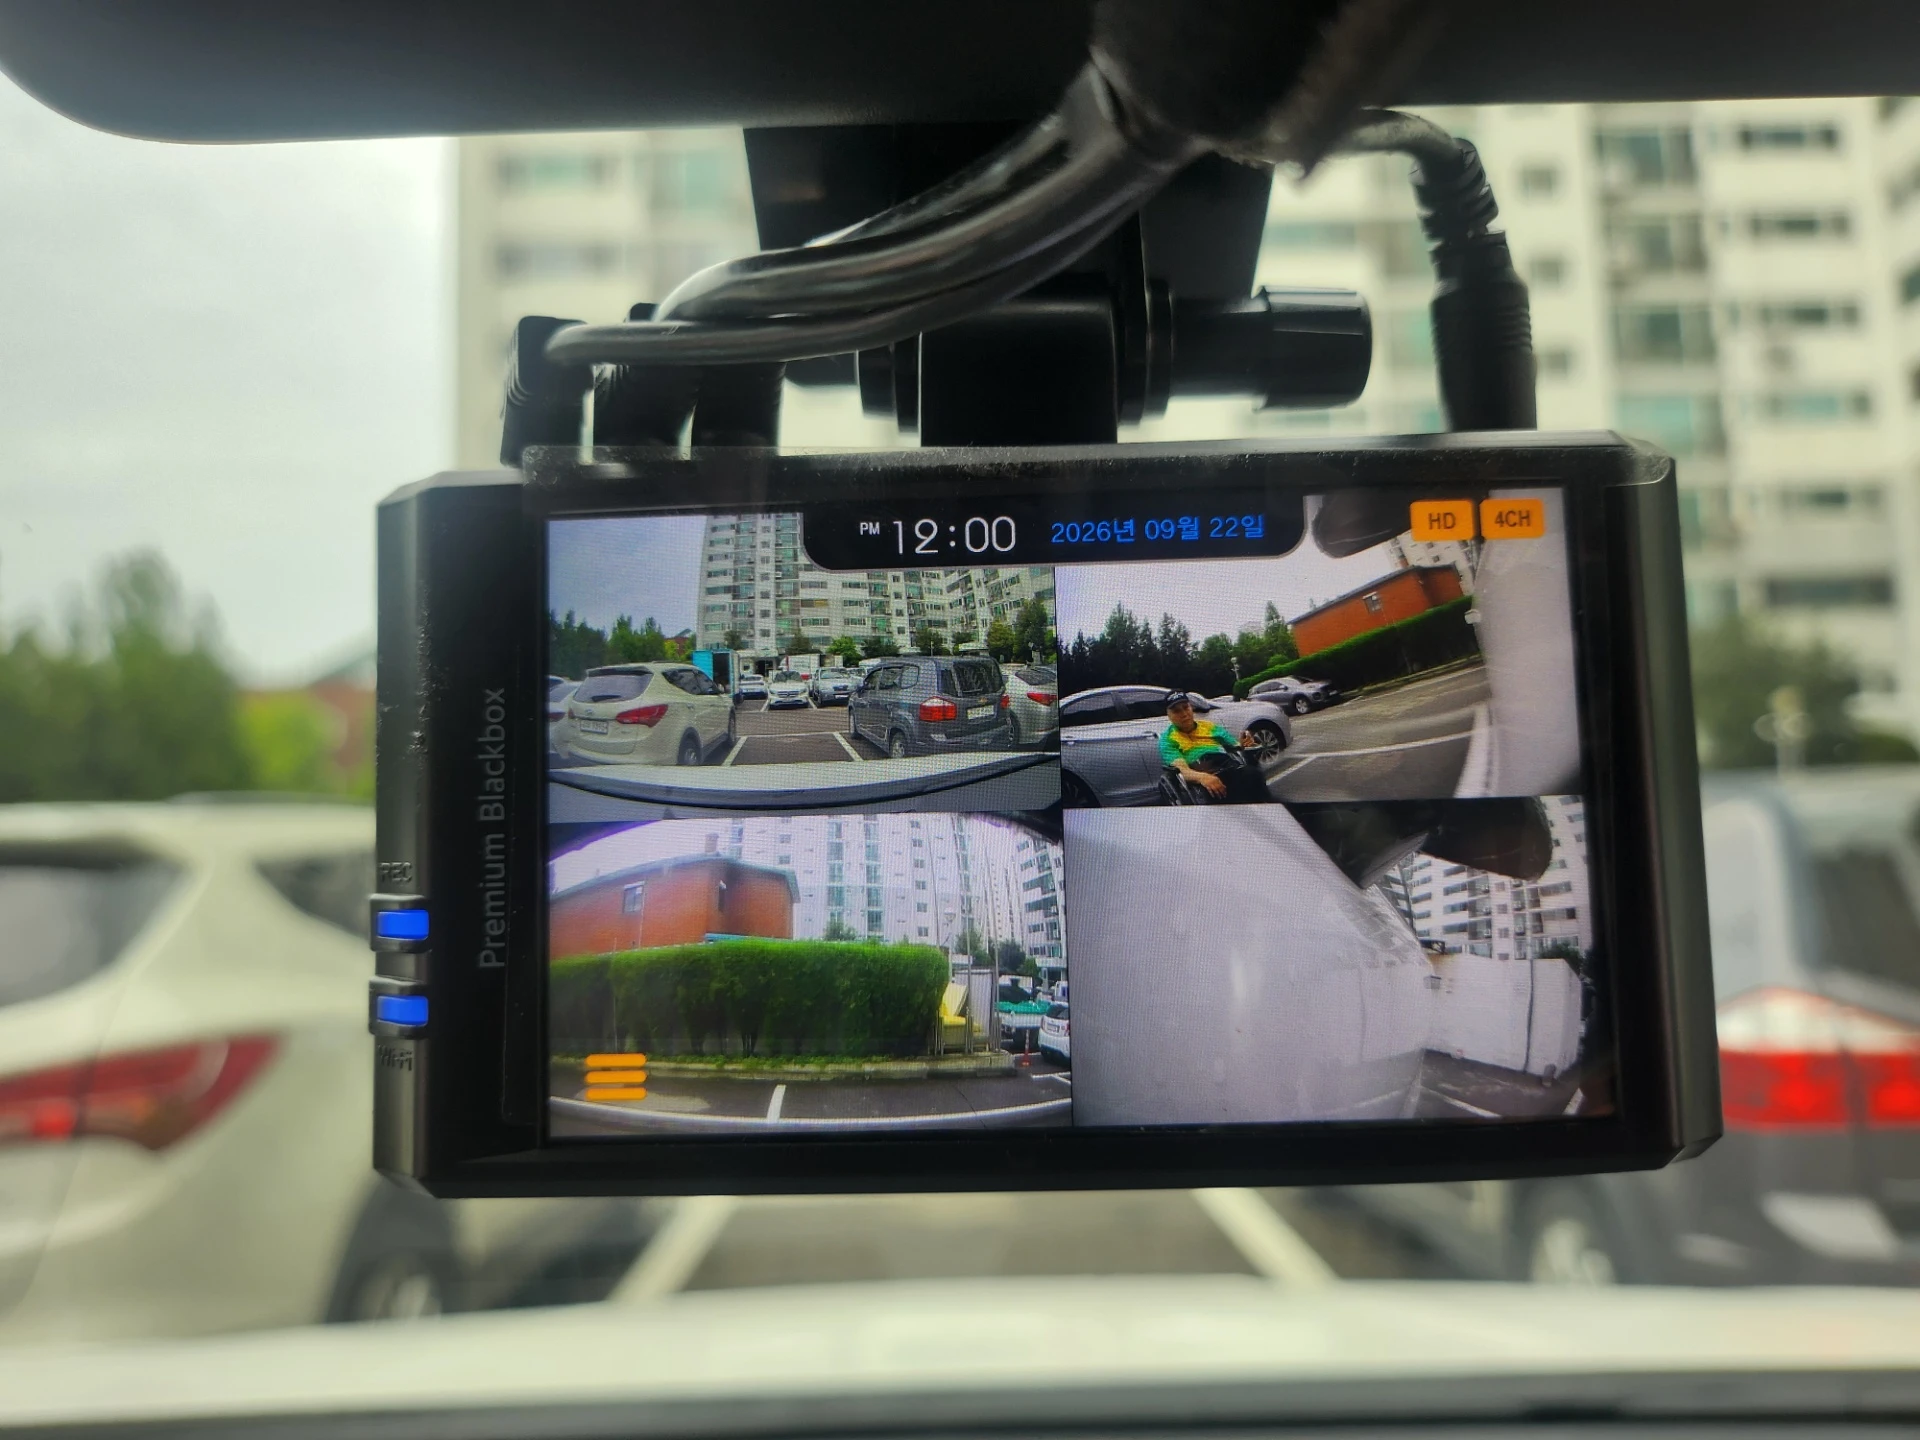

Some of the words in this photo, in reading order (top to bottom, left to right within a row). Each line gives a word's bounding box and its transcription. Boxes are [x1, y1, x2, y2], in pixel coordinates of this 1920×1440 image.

[1051, 517, 1136, 543] 2026년
[1144, 515, 1200, 541] 09월
[1209, 513, 1265, 539] 22일
[1427, 511, 1457, 530] HD
[1493, 509, 1532, 528] 4CH
[859, 521, 880, 536] PM
[892, 515, 1016, 555] 12:00
[476, 687, 506, 821] Blackbox
[380, 861, 413, 882] REC
[478, 833, 506, 969] Premium
